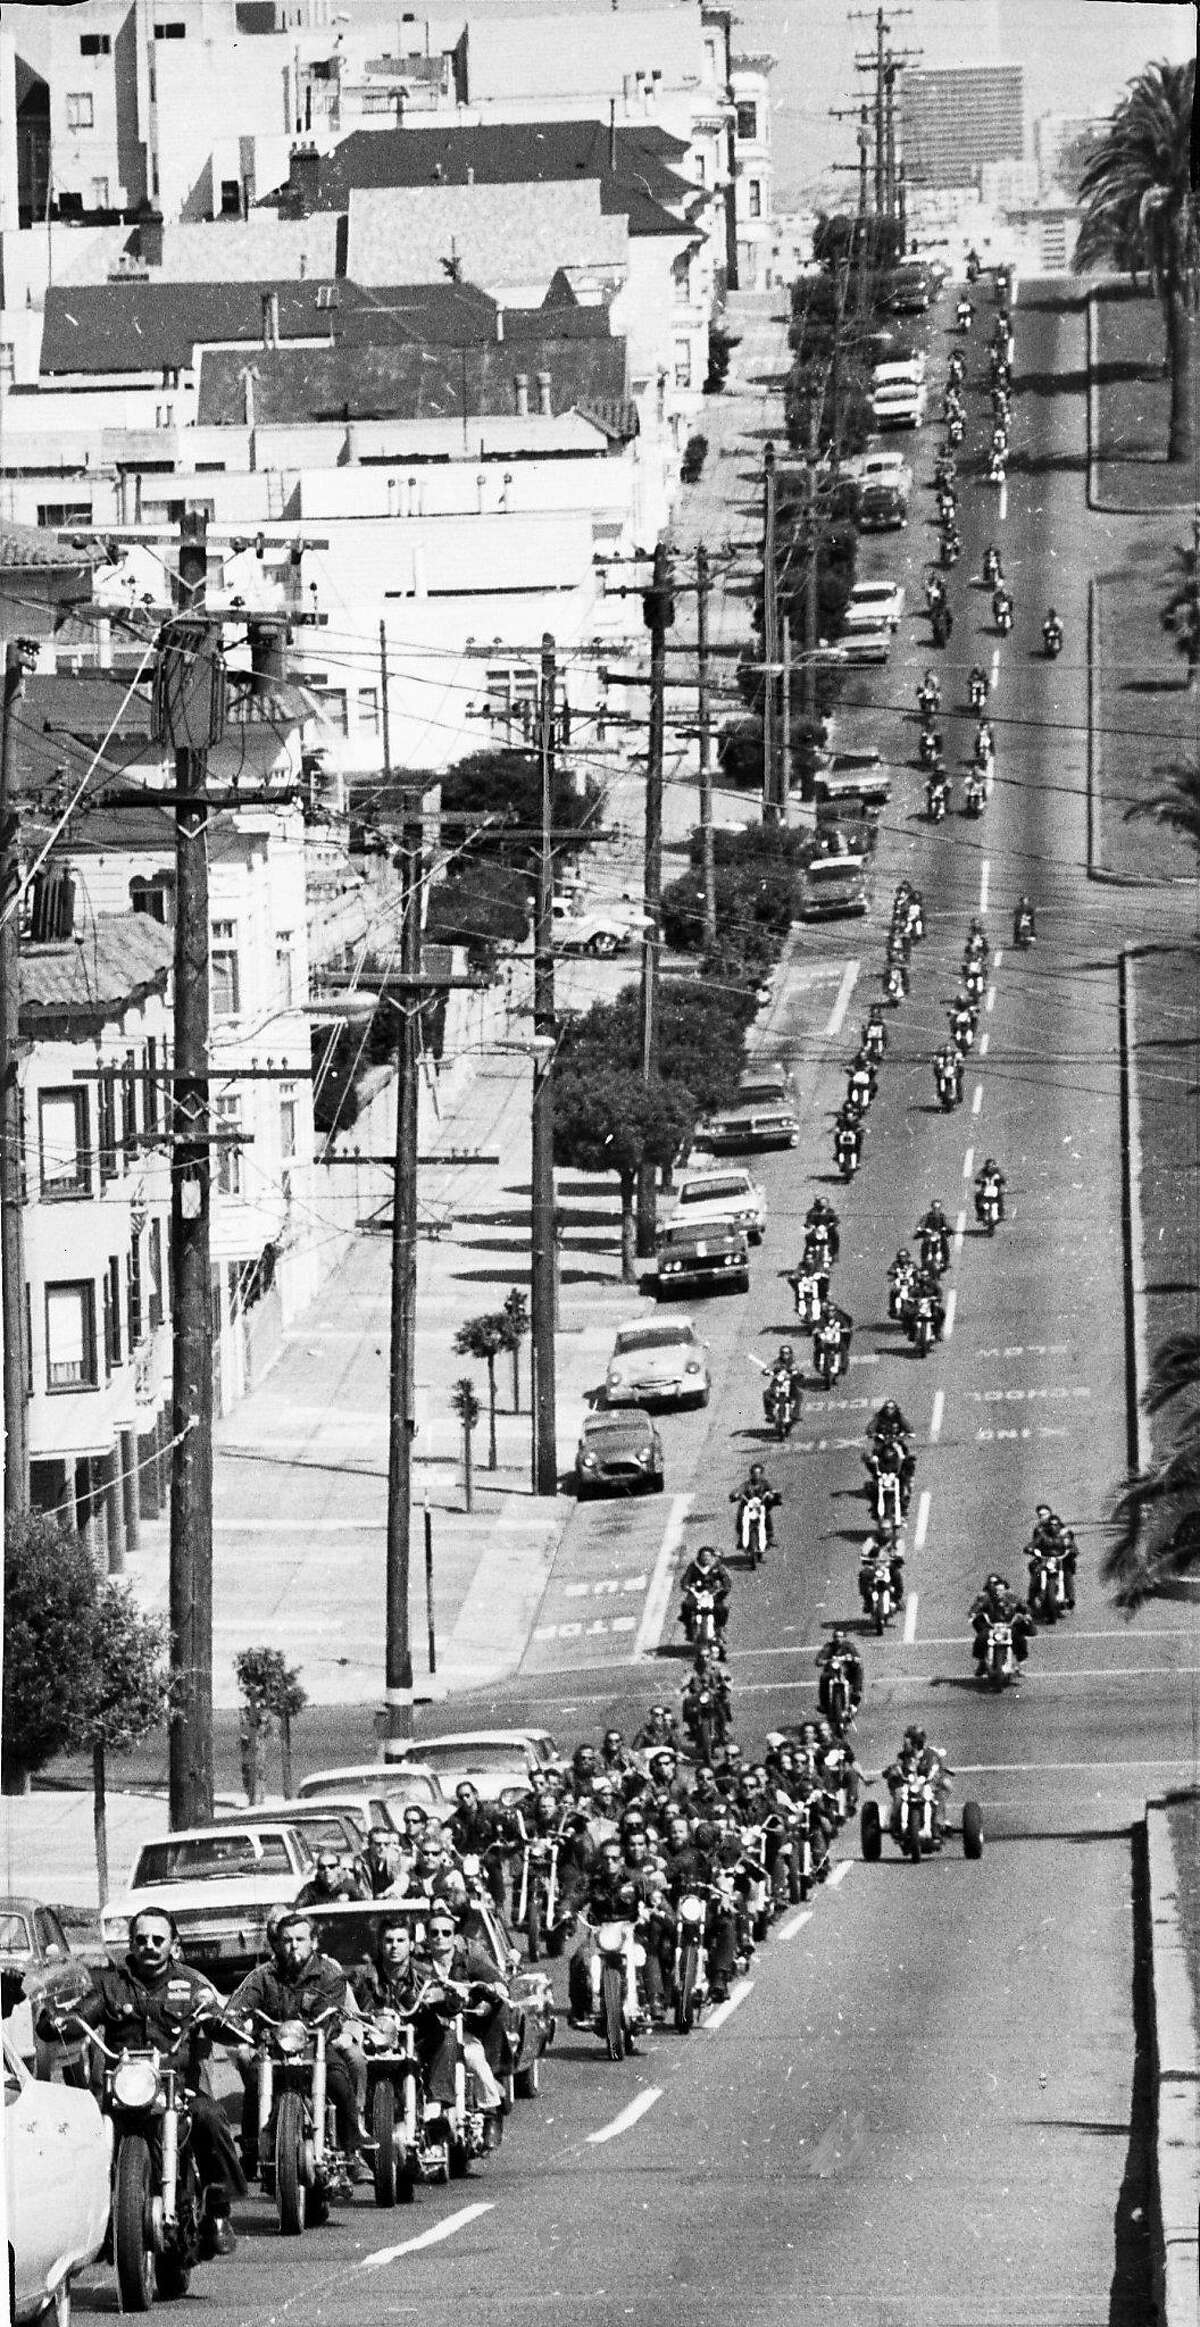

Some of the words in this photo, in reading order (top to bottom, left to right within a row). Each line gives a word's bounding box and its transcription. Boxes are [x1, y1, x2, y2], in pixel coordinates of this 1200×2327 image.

[963, 1386, 1092, 1401] SCHOOL
[974, 1427, 1069, 1441] XING
[534, 1616, 637, 1640] STOP
